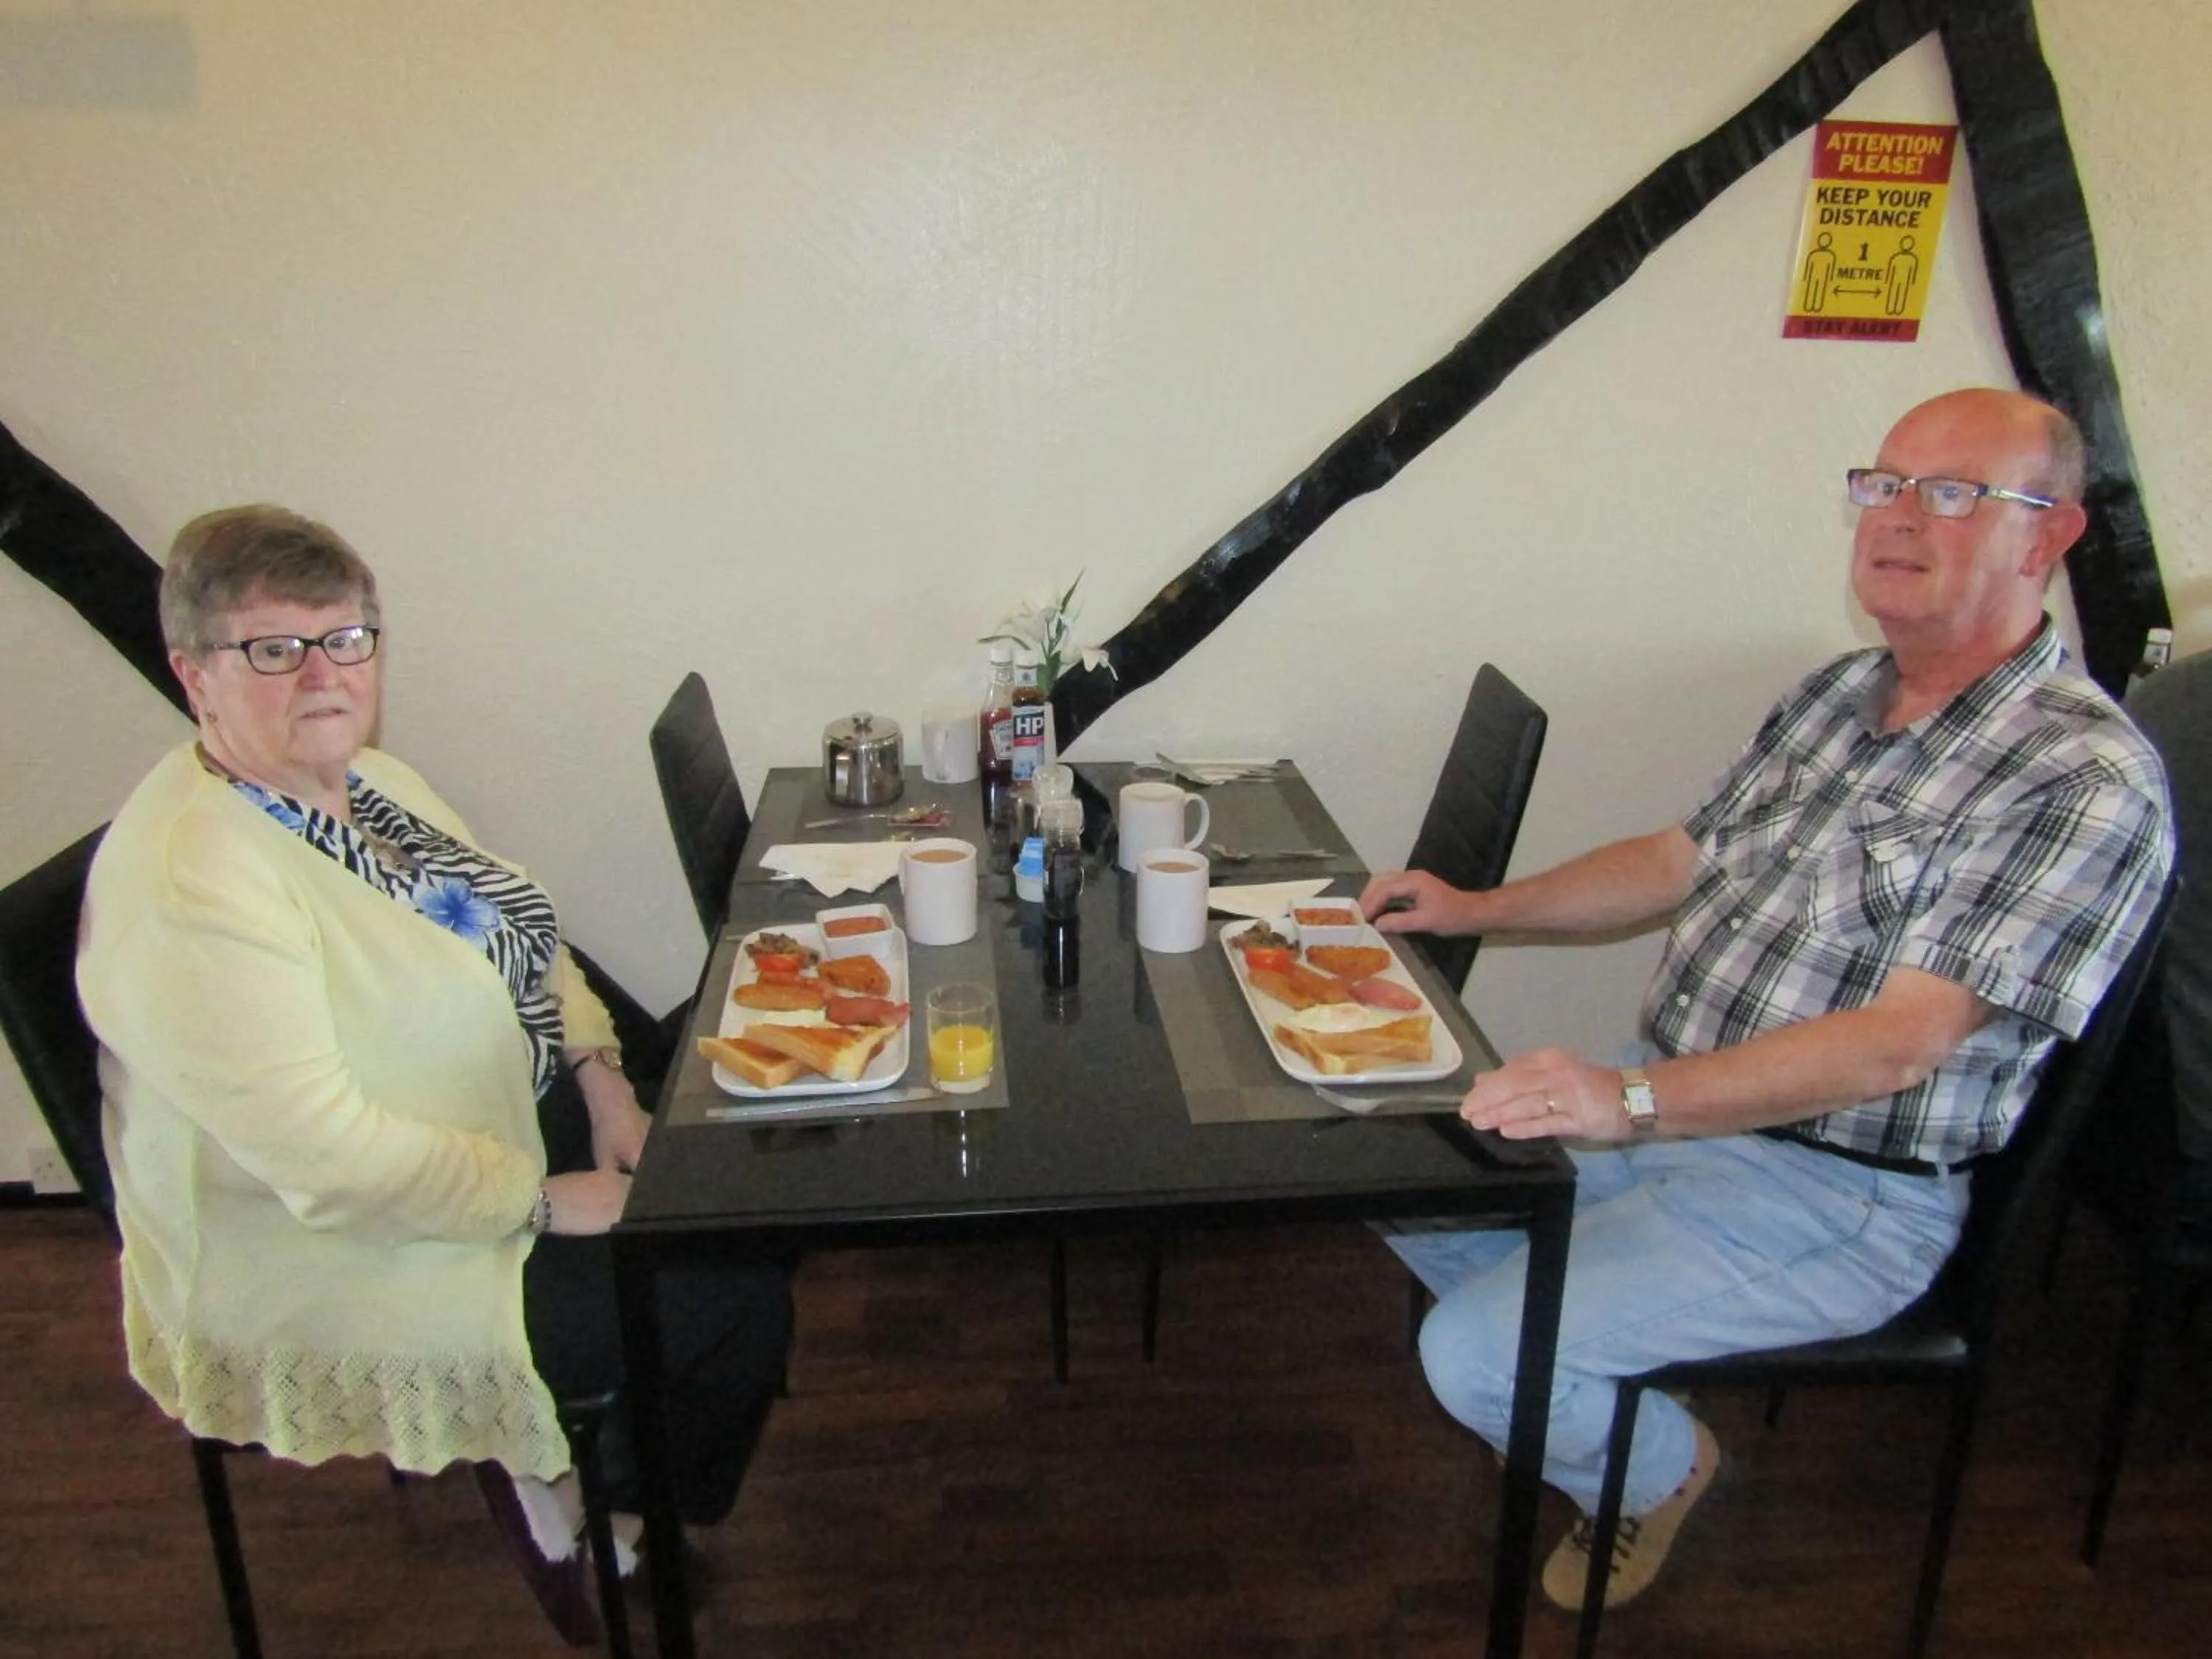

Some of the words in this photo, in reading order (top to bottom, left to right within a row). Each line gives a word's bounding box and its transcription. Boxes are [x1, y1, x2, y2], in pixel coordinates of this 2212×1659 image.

[1825, 132, 1944, 155] ATTENTION
[1838, 154, 1926, 175] PLEASE!
[1816, 187, 1870, 205] KEEP
[1877, 189, 1933, 209] YOUR
[1819, 207, 1921, 229] DISTANCE
[1857, 242, 1869, 261] 1
[1836, 268, 1883, 281] METRE
[1015, 716, 1044, 735] HP
